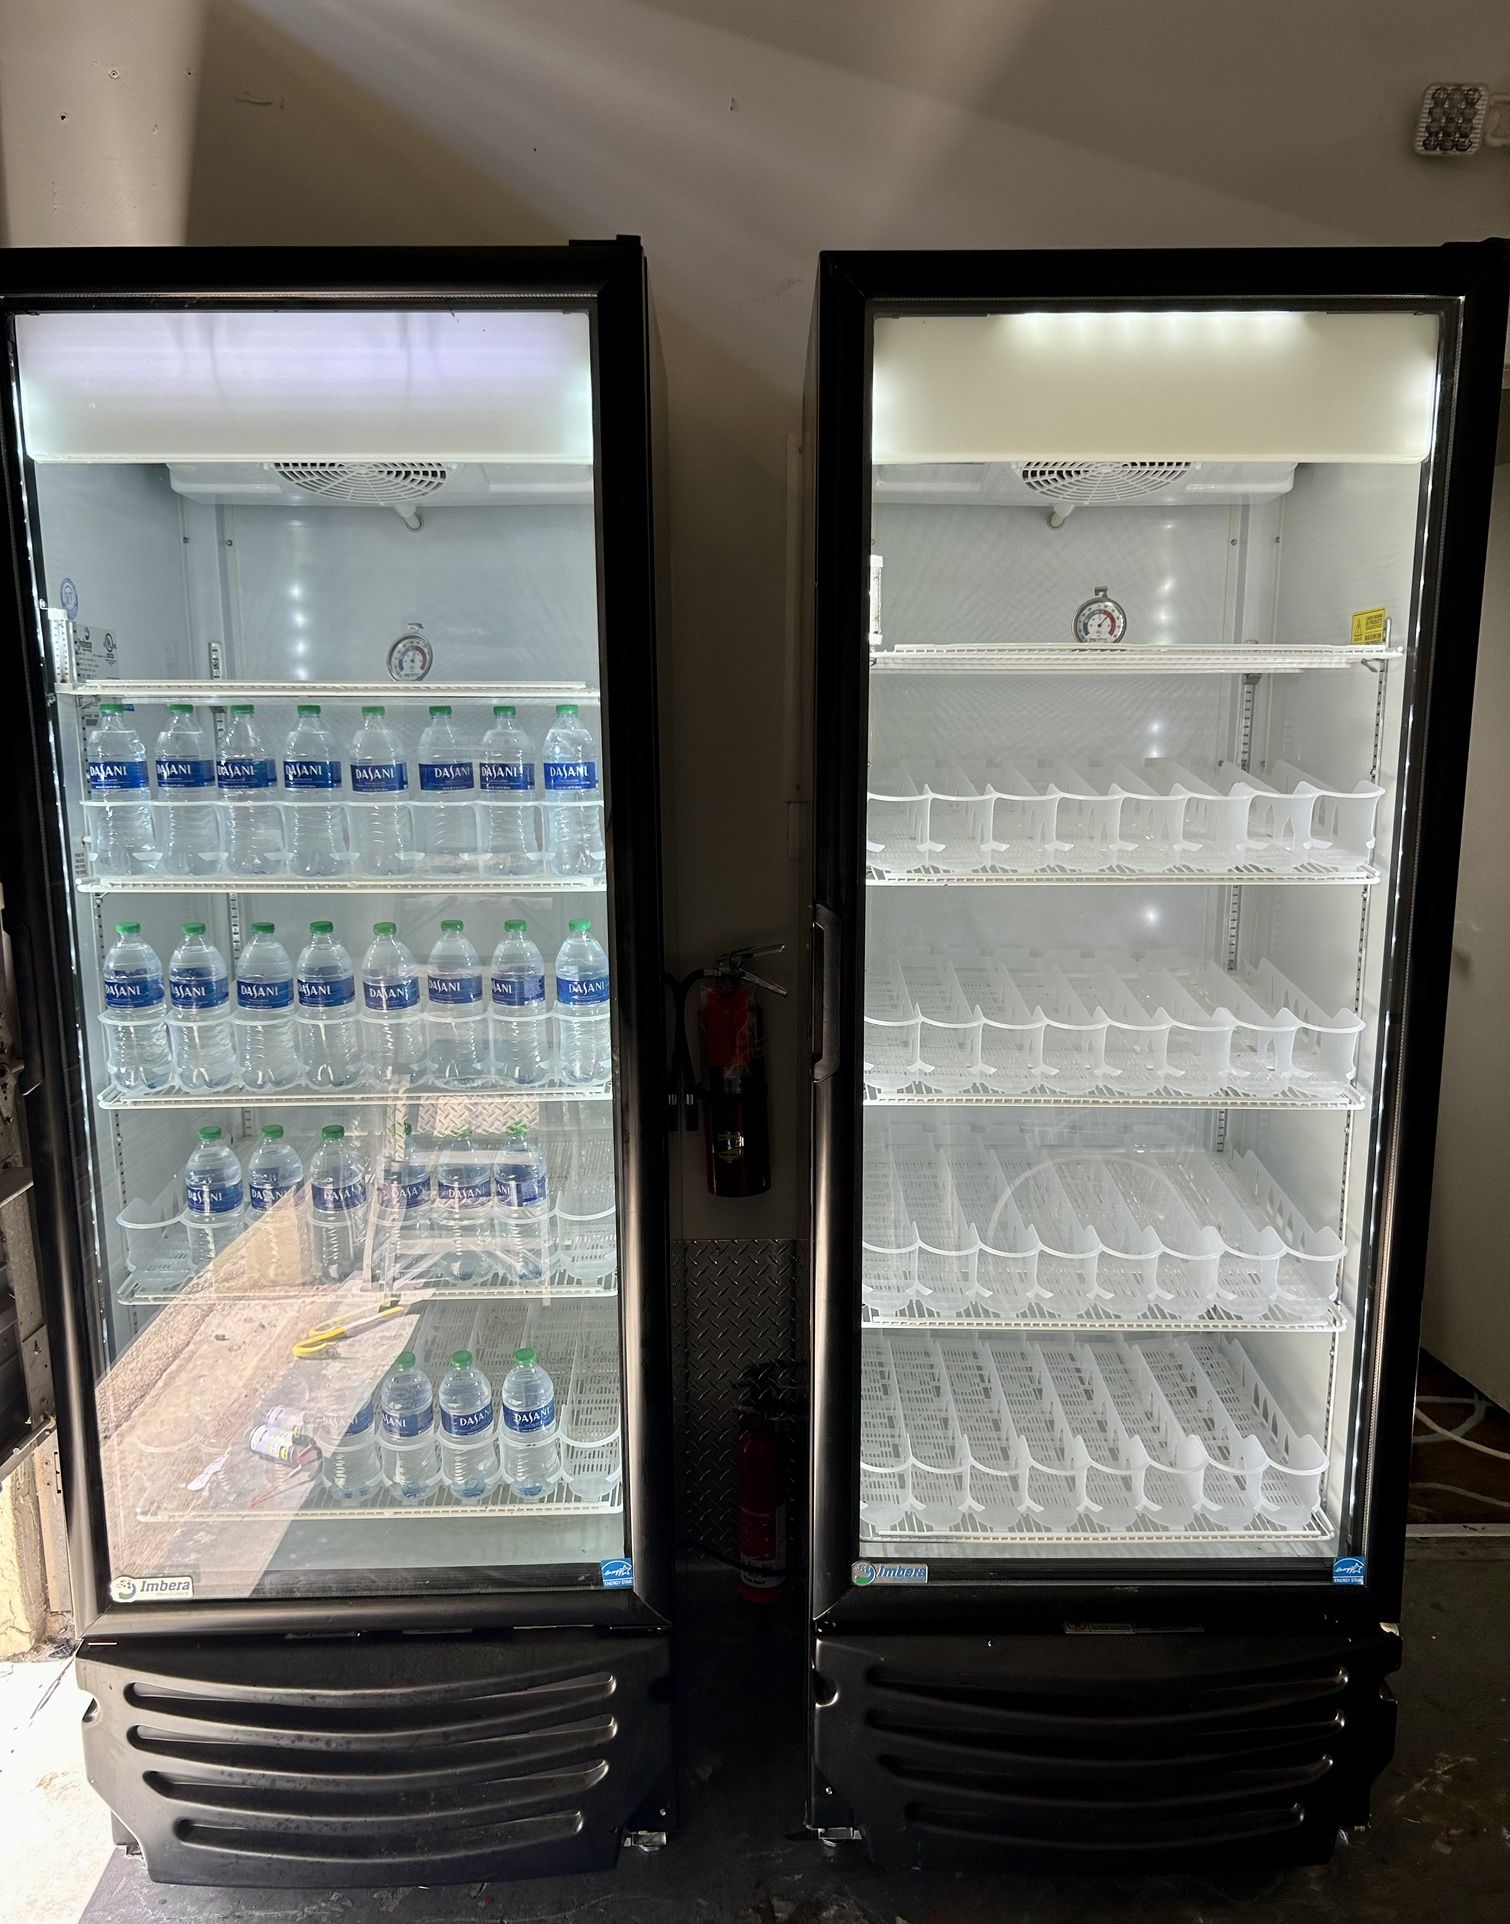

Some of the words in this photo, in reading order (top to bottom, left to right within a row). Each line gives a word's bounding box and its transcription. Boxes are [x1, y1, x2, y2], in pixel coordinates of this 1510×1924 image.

[89, 763, 127, 779] DASANI
[285, 764, 322, 777] DASANI
[355, 766, 394, 780] DASANI
[434, 764, 471, 779] DASANI
[481, 765, 517, 780] DASANI
[550, 765, 589, 780] DASANI
[105, 983, 141, 999] DASANI
[240, 984, 278, 999] DASANI
[369, 984, 407, 1000] DASANI
[428, 979, 461, 994] DASANI
[568, 980, 605, 996] DASANI
[187, 1189, 223, 1204] DASANI
[448, 1185, 486, 1202] DASANI
[514, 1407, 551, 1424] DASANI
[140, 1580, 190, 1592] Imbera
